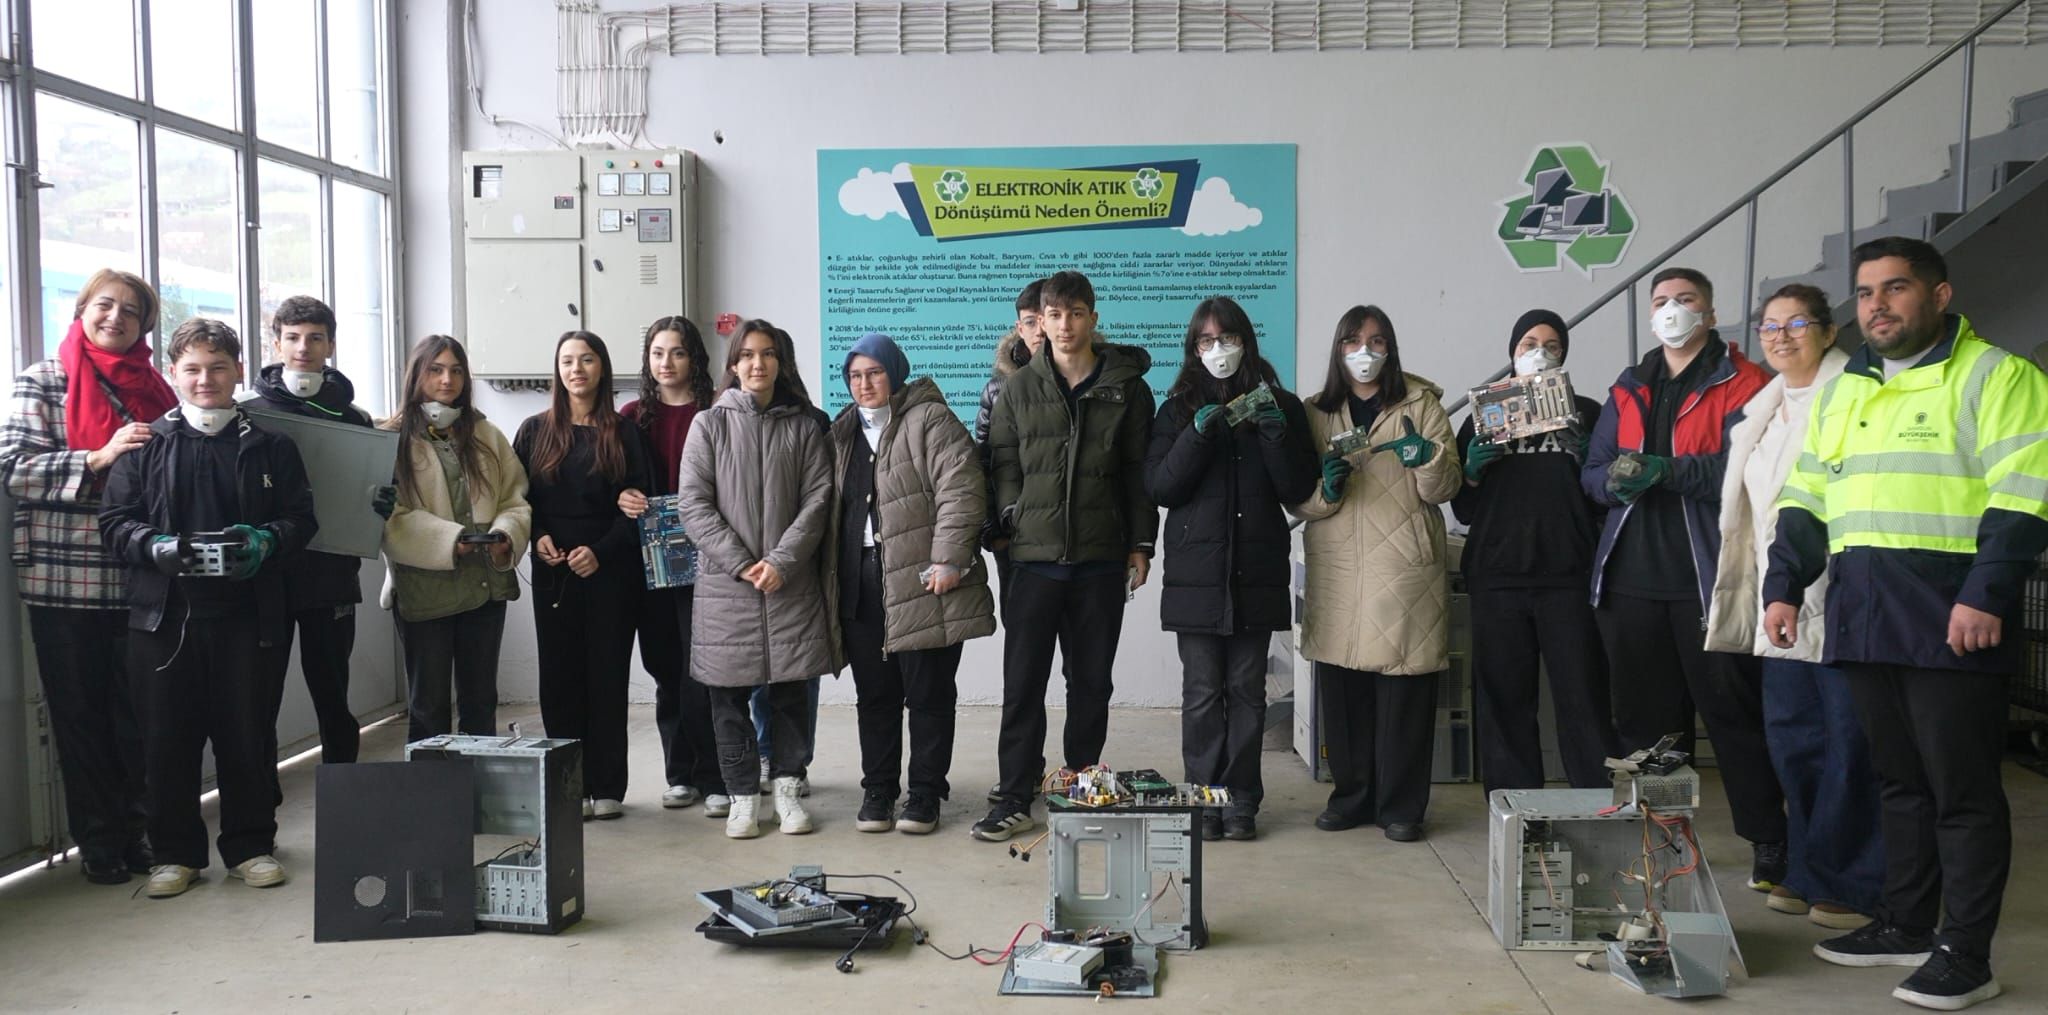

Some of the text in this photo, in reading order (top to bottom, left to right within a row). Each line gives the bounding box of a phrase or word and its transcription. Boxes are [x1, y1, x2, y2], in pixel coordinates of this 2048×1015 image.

[975, 178, 1084, 197] ELEKTRONİK
[1087, 180, 1127, 195] ATIK
[934, 200, 1168, 223] Dönüşümü Neden Önemli?
